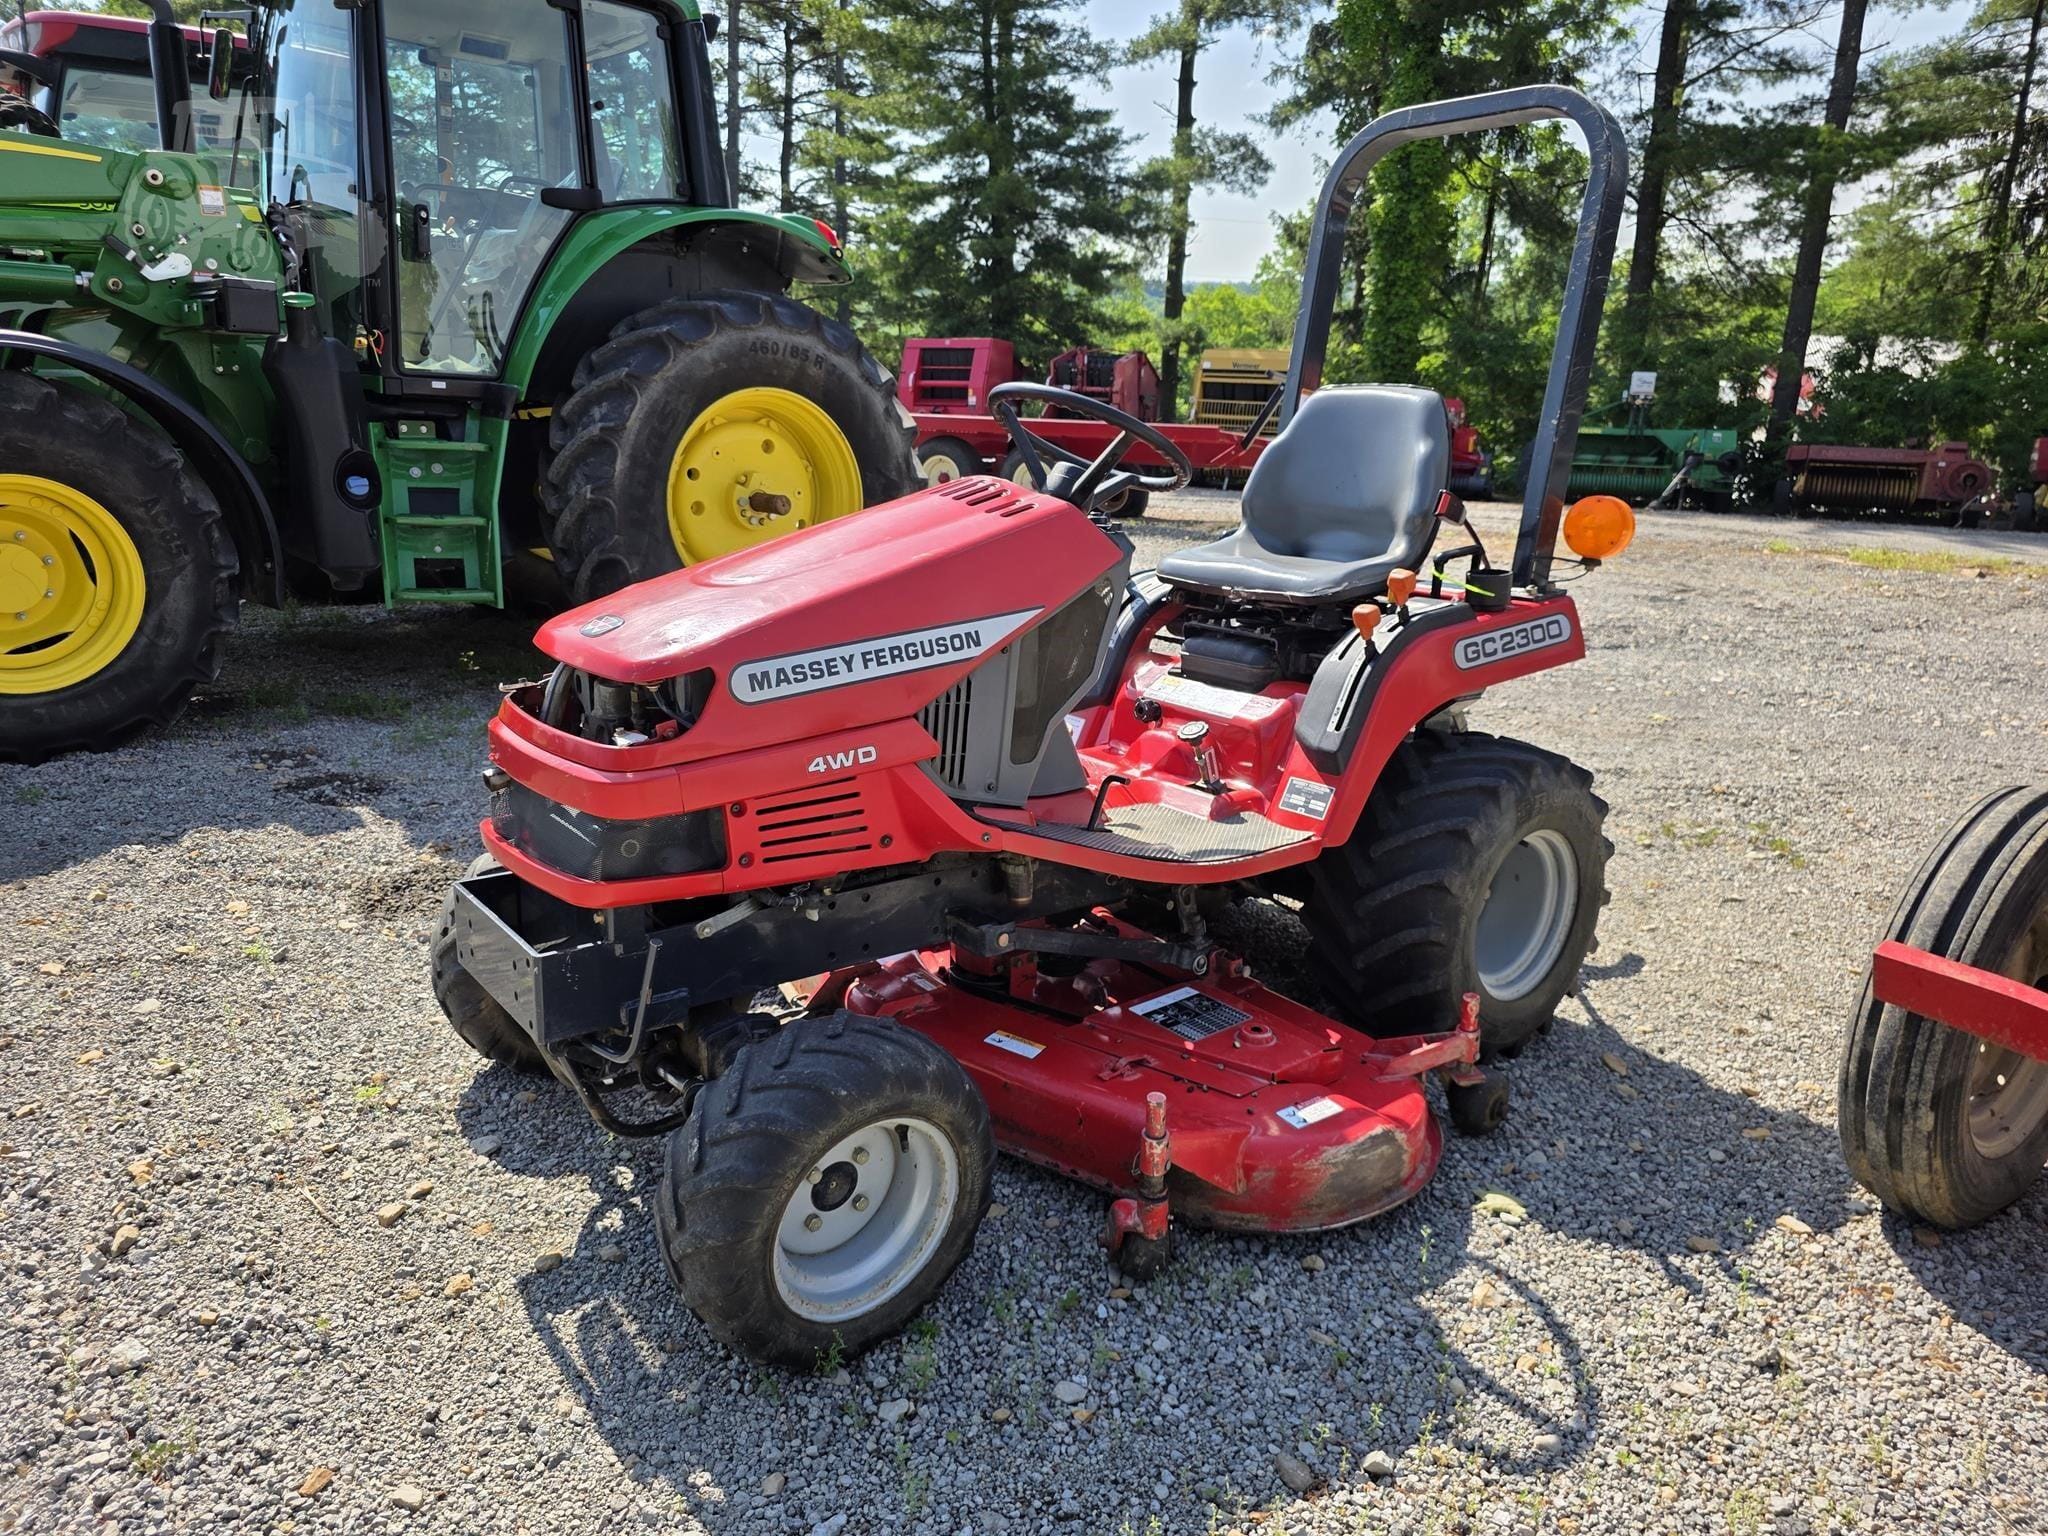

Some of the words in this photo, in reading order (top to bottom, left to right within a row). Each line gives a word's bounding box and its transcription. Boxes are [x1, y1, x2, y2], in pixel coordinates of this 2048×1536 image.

[747, 653, 856, 693] MASSEY
[860, 630, 982, 670] FERGUSON
[1463, 619, 1562, 663] GC2300
[807, 745, 878, 773] 4WD
